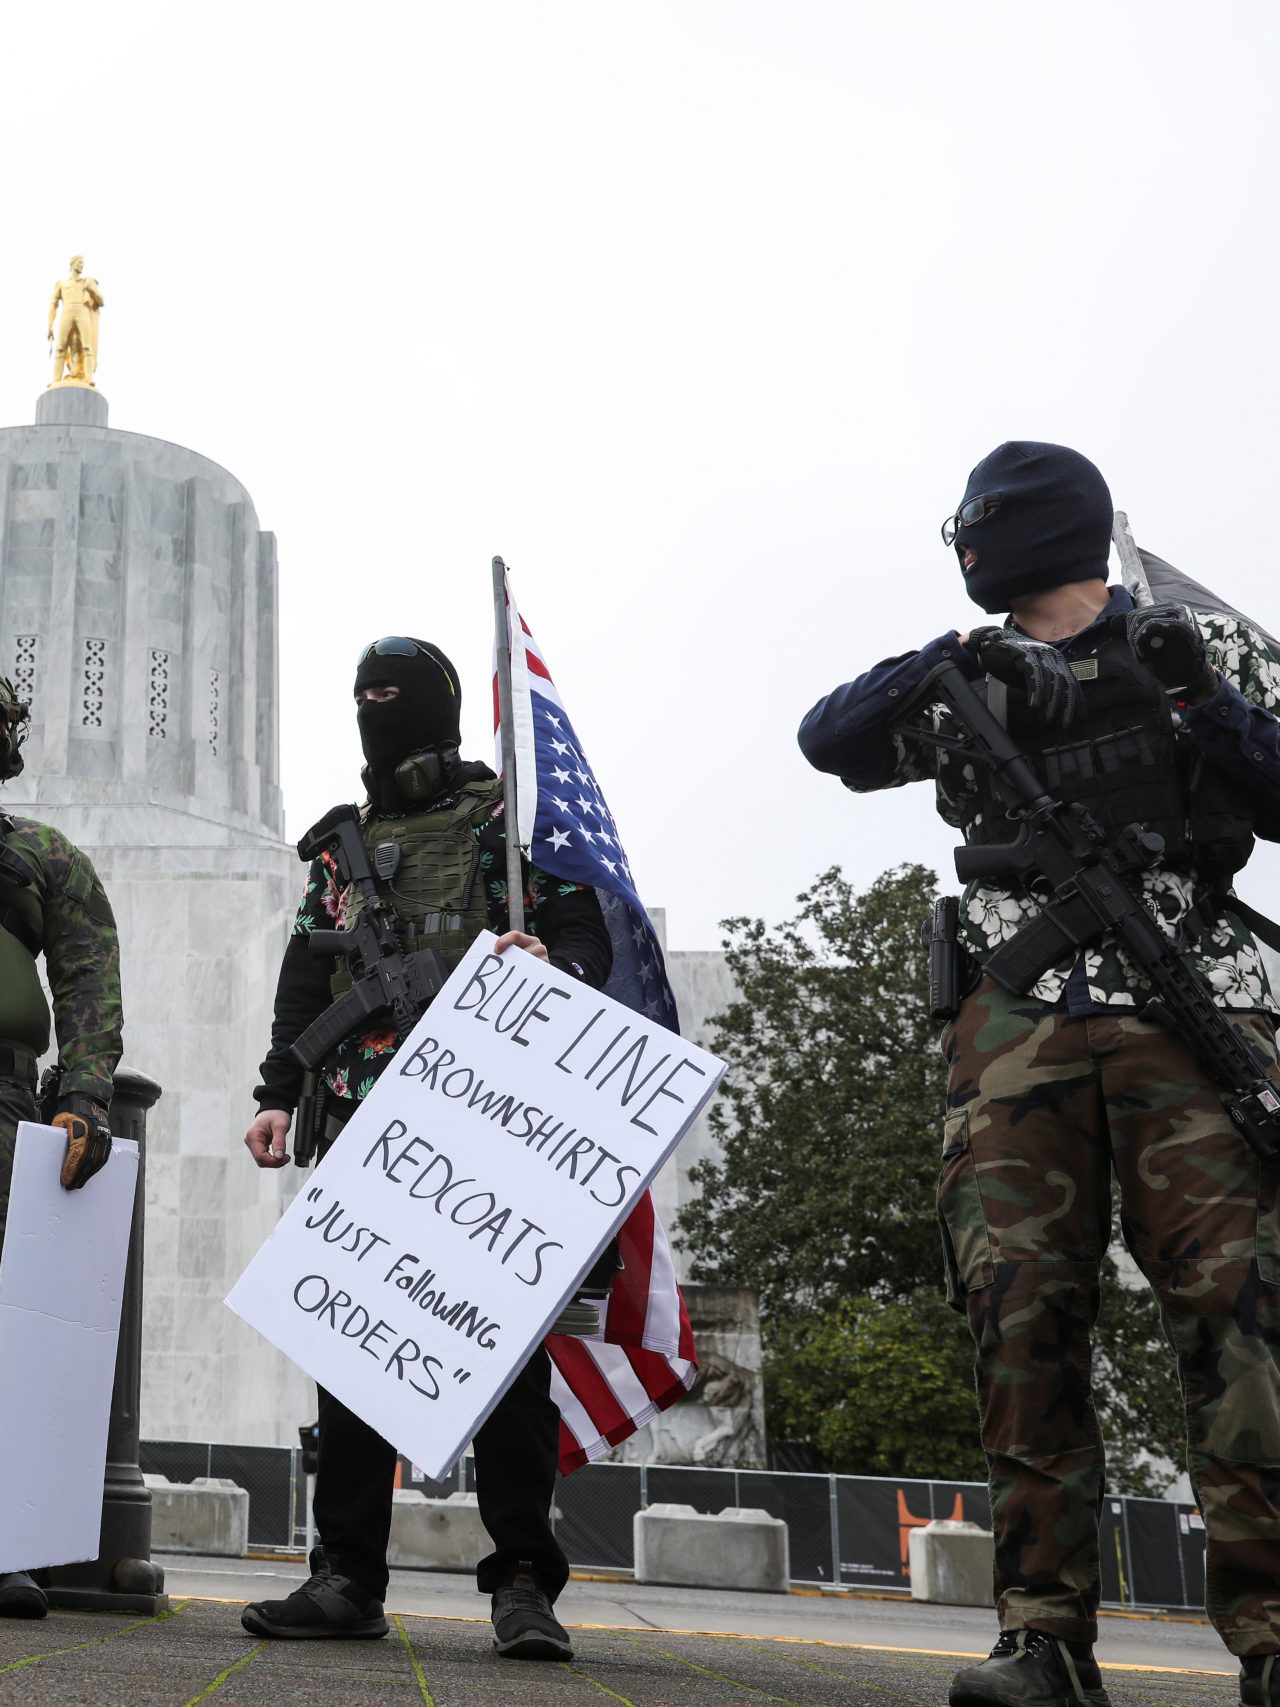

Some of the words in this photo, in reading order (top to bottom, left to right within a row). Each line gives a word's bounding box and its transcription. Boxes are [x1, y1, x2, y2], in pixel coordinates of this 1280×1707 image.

[399, 1037, 641, 1209] BROWNSHIRTS
[453, 953, 572, 1047] BLUE
[554, 1009, 706, 1137] LINE
[305, 1188, 391, 1262] "JUST
[362, 1119, 564, 1286] REDCOATS
[293, 1274, 472, 1401] ORDERS"
